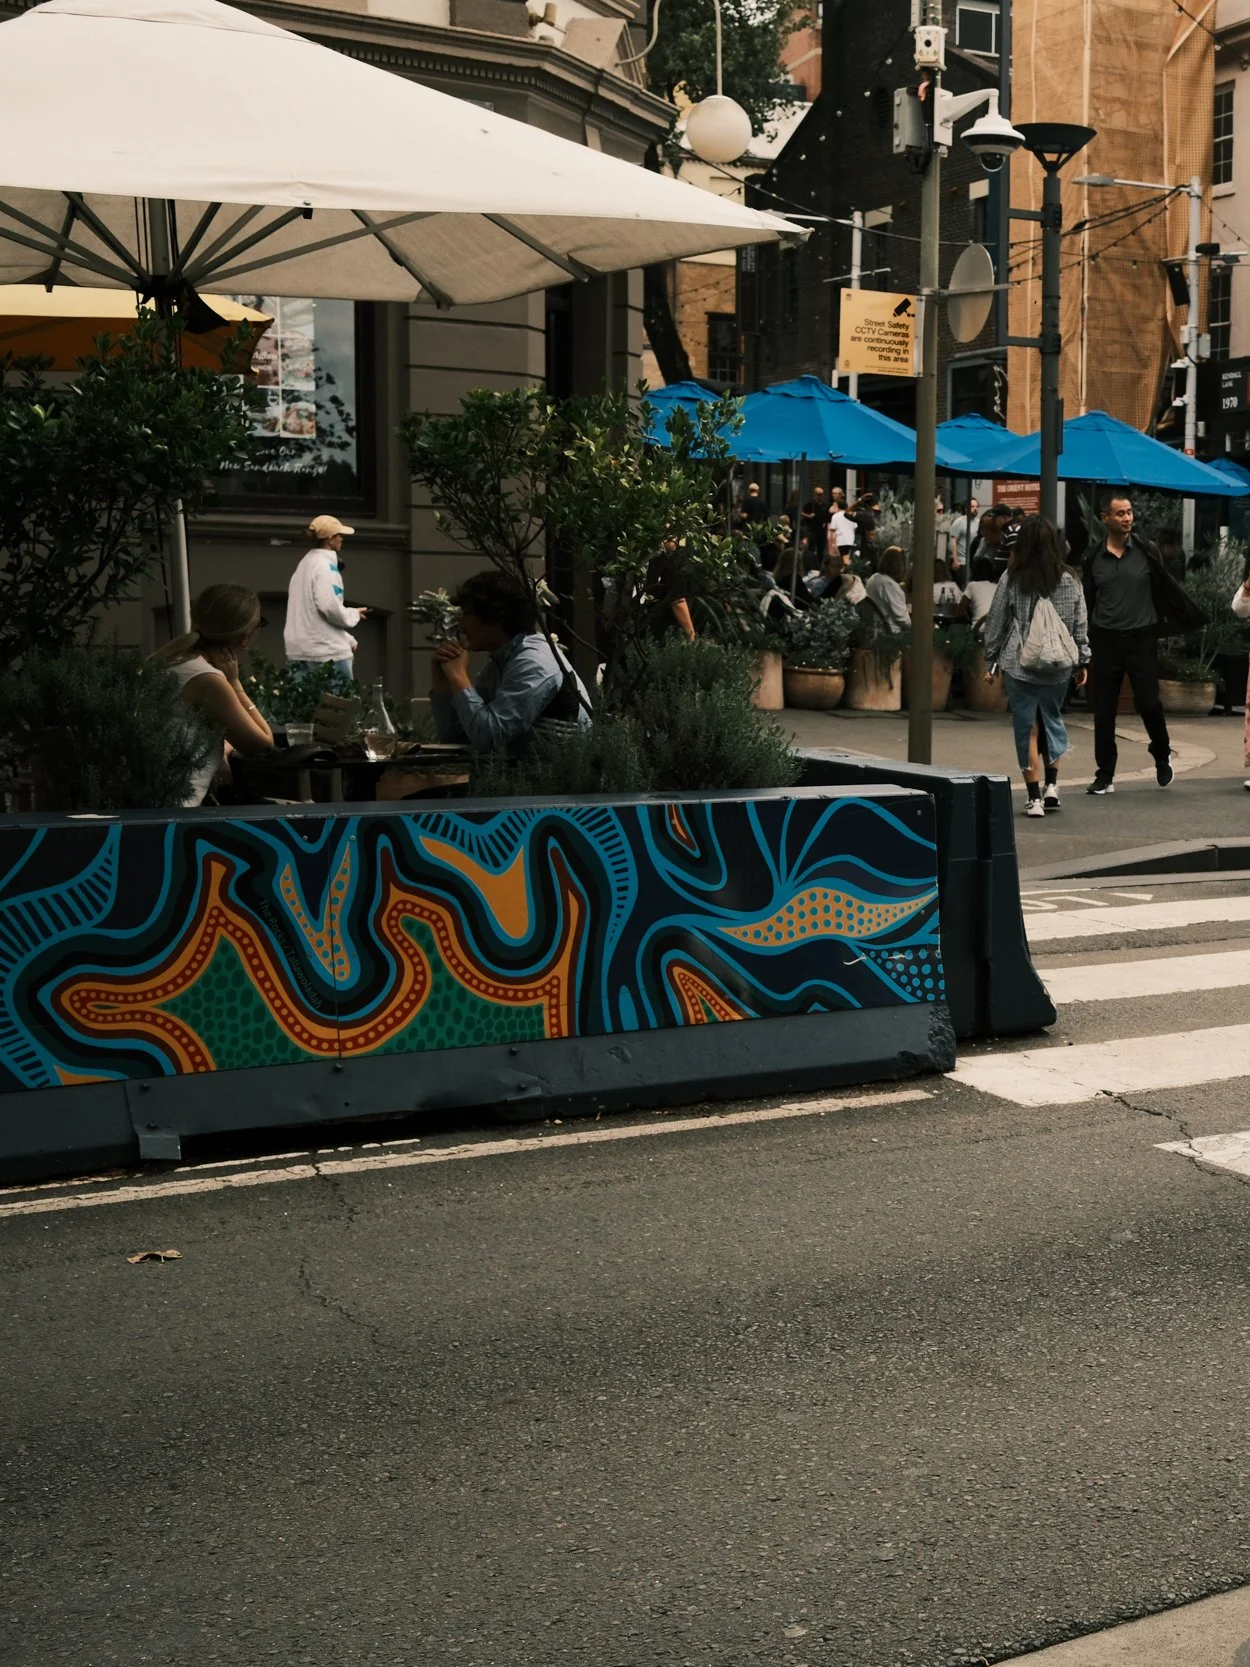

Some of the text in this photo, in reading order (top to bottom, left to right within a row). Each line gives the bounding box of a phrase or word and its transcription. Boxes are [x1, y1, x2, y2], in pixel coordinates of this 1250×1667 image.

[864, 318, 910, 331] Street Safety
[855, 326, 910, 339] CCTV Cameras
[863, 337, 909, 348] continuously
[867, 345, 901, 356] recording
[1222, 396, 1238, 409] 1970
